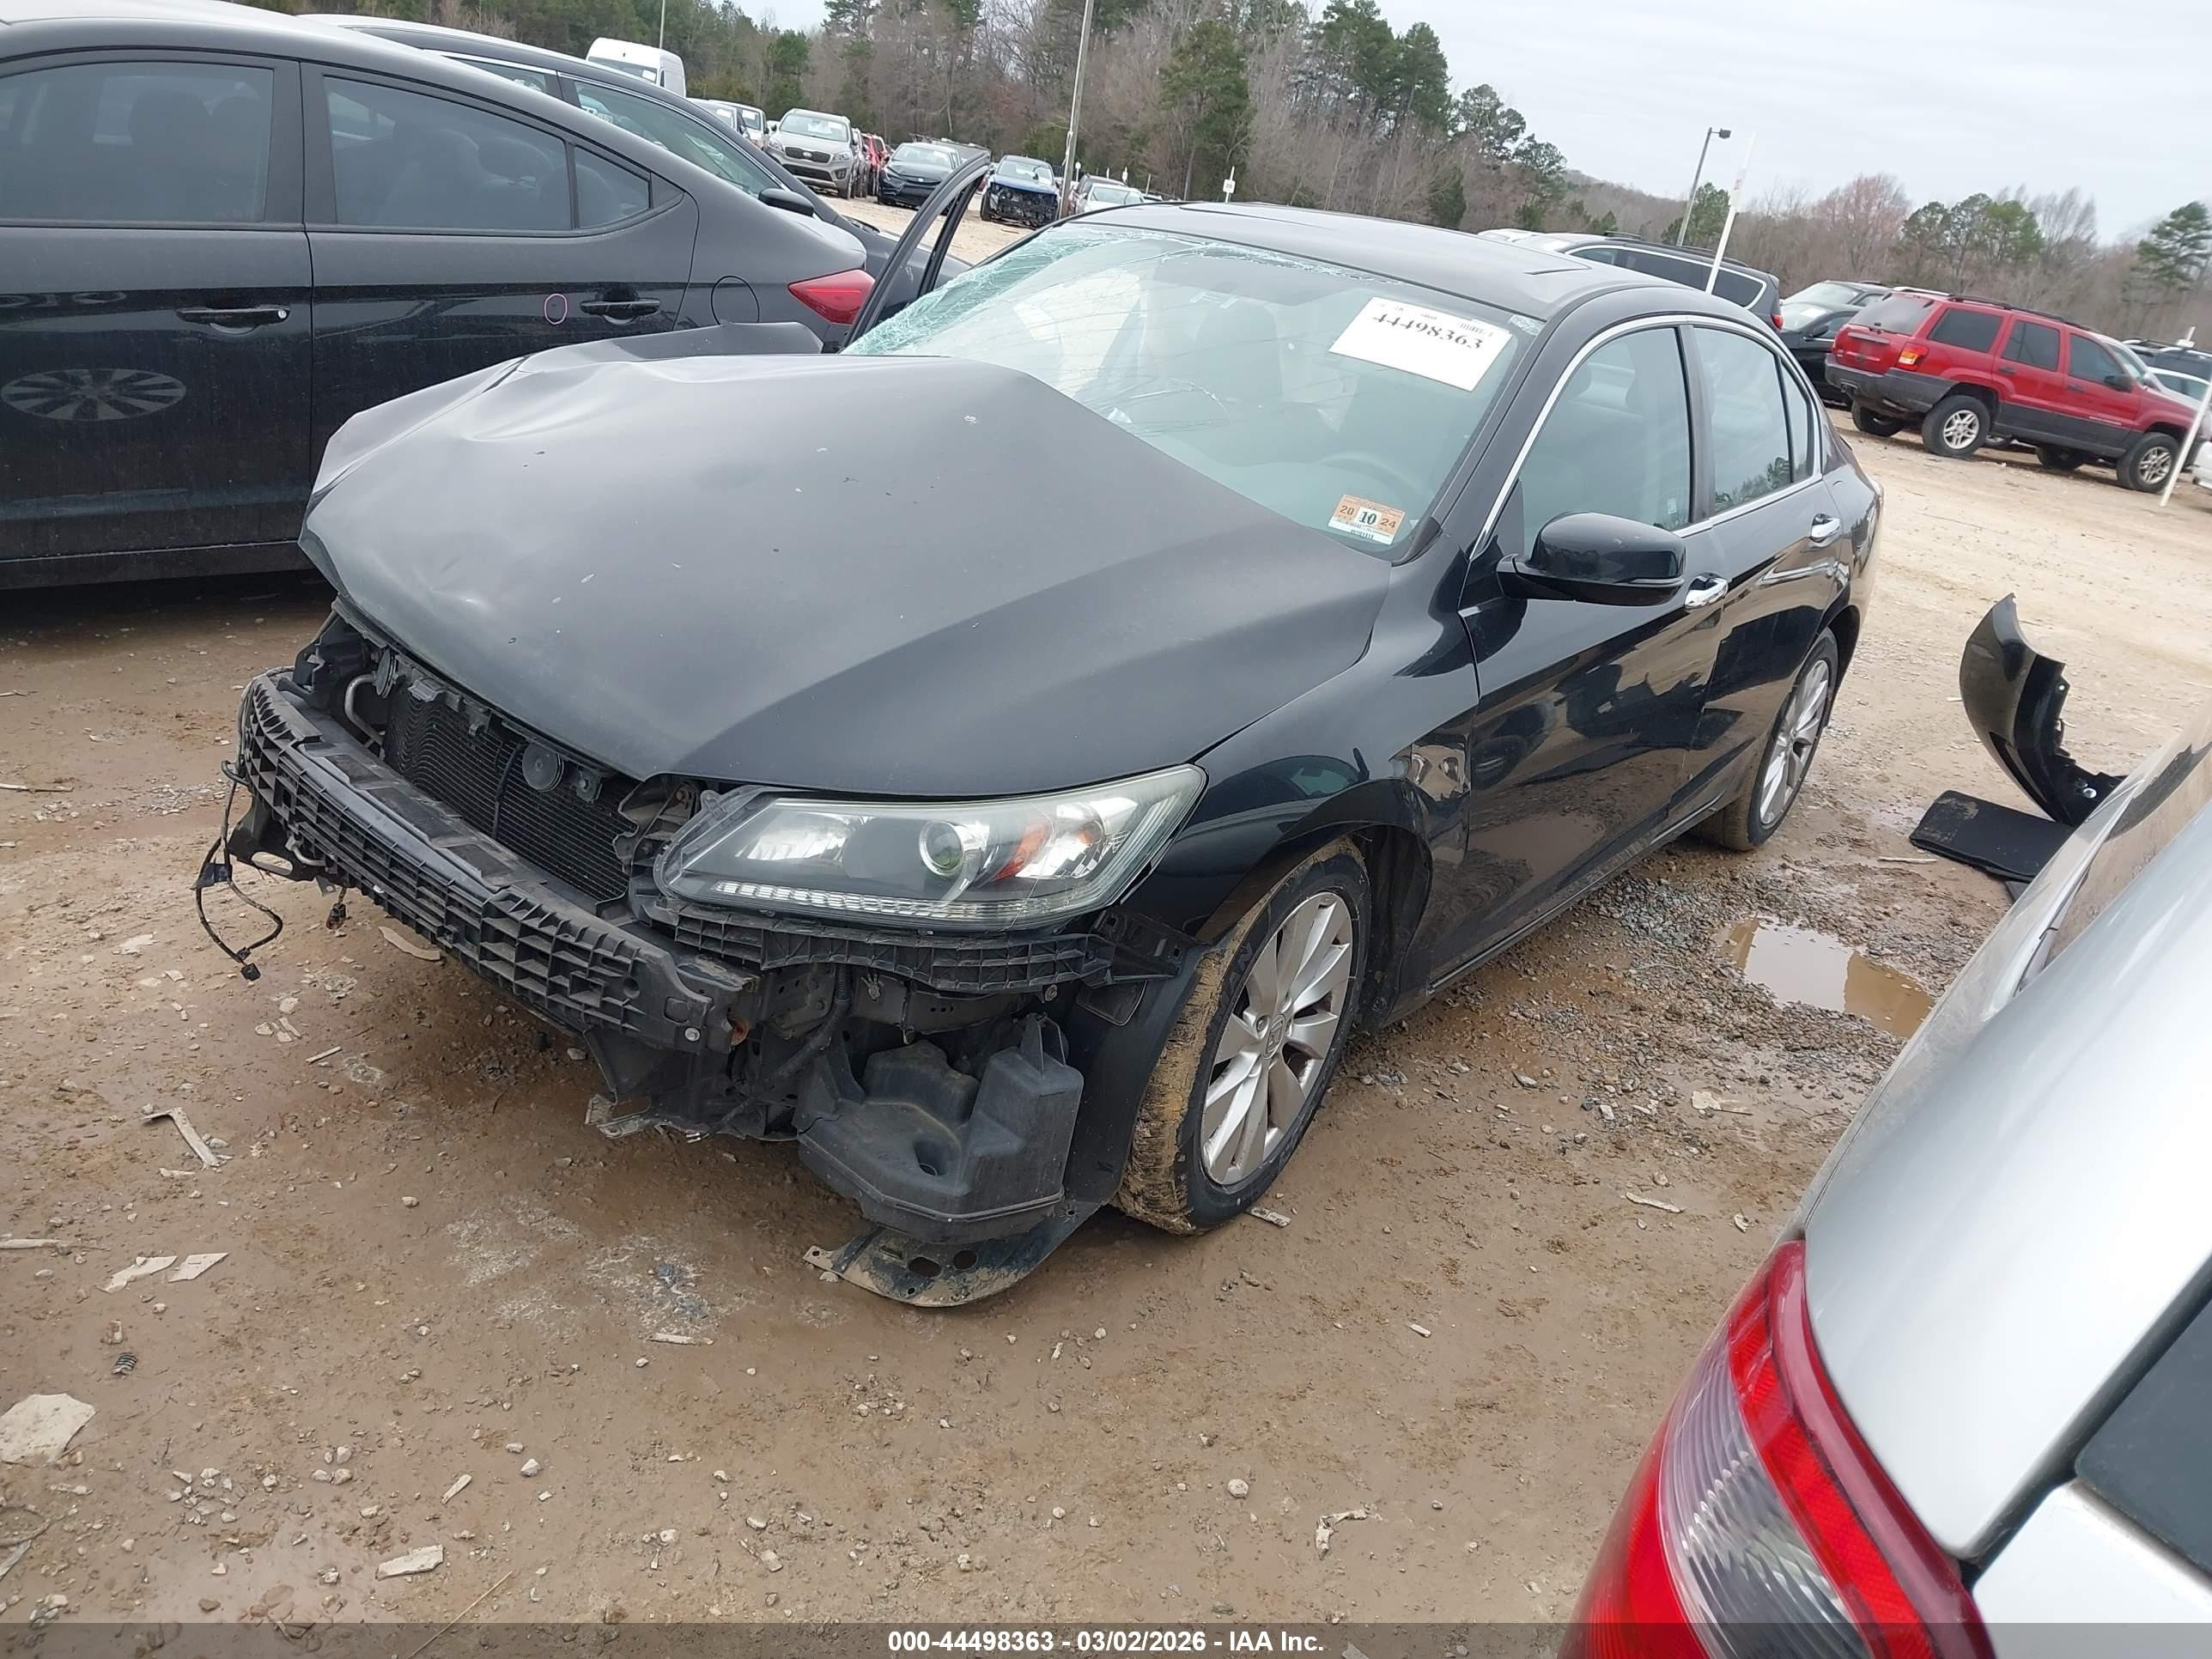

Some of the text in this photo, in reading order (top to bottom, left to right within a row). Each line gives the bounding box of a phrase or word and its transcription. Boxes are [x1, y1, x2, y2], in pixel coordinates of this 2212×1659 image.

[1373, 313, 1484, 349] 44498363
[1340, 505, 1355, 516] 20
[1358, 511, 1377, 525] 10
[1380, 518, 1396, 528] 24
